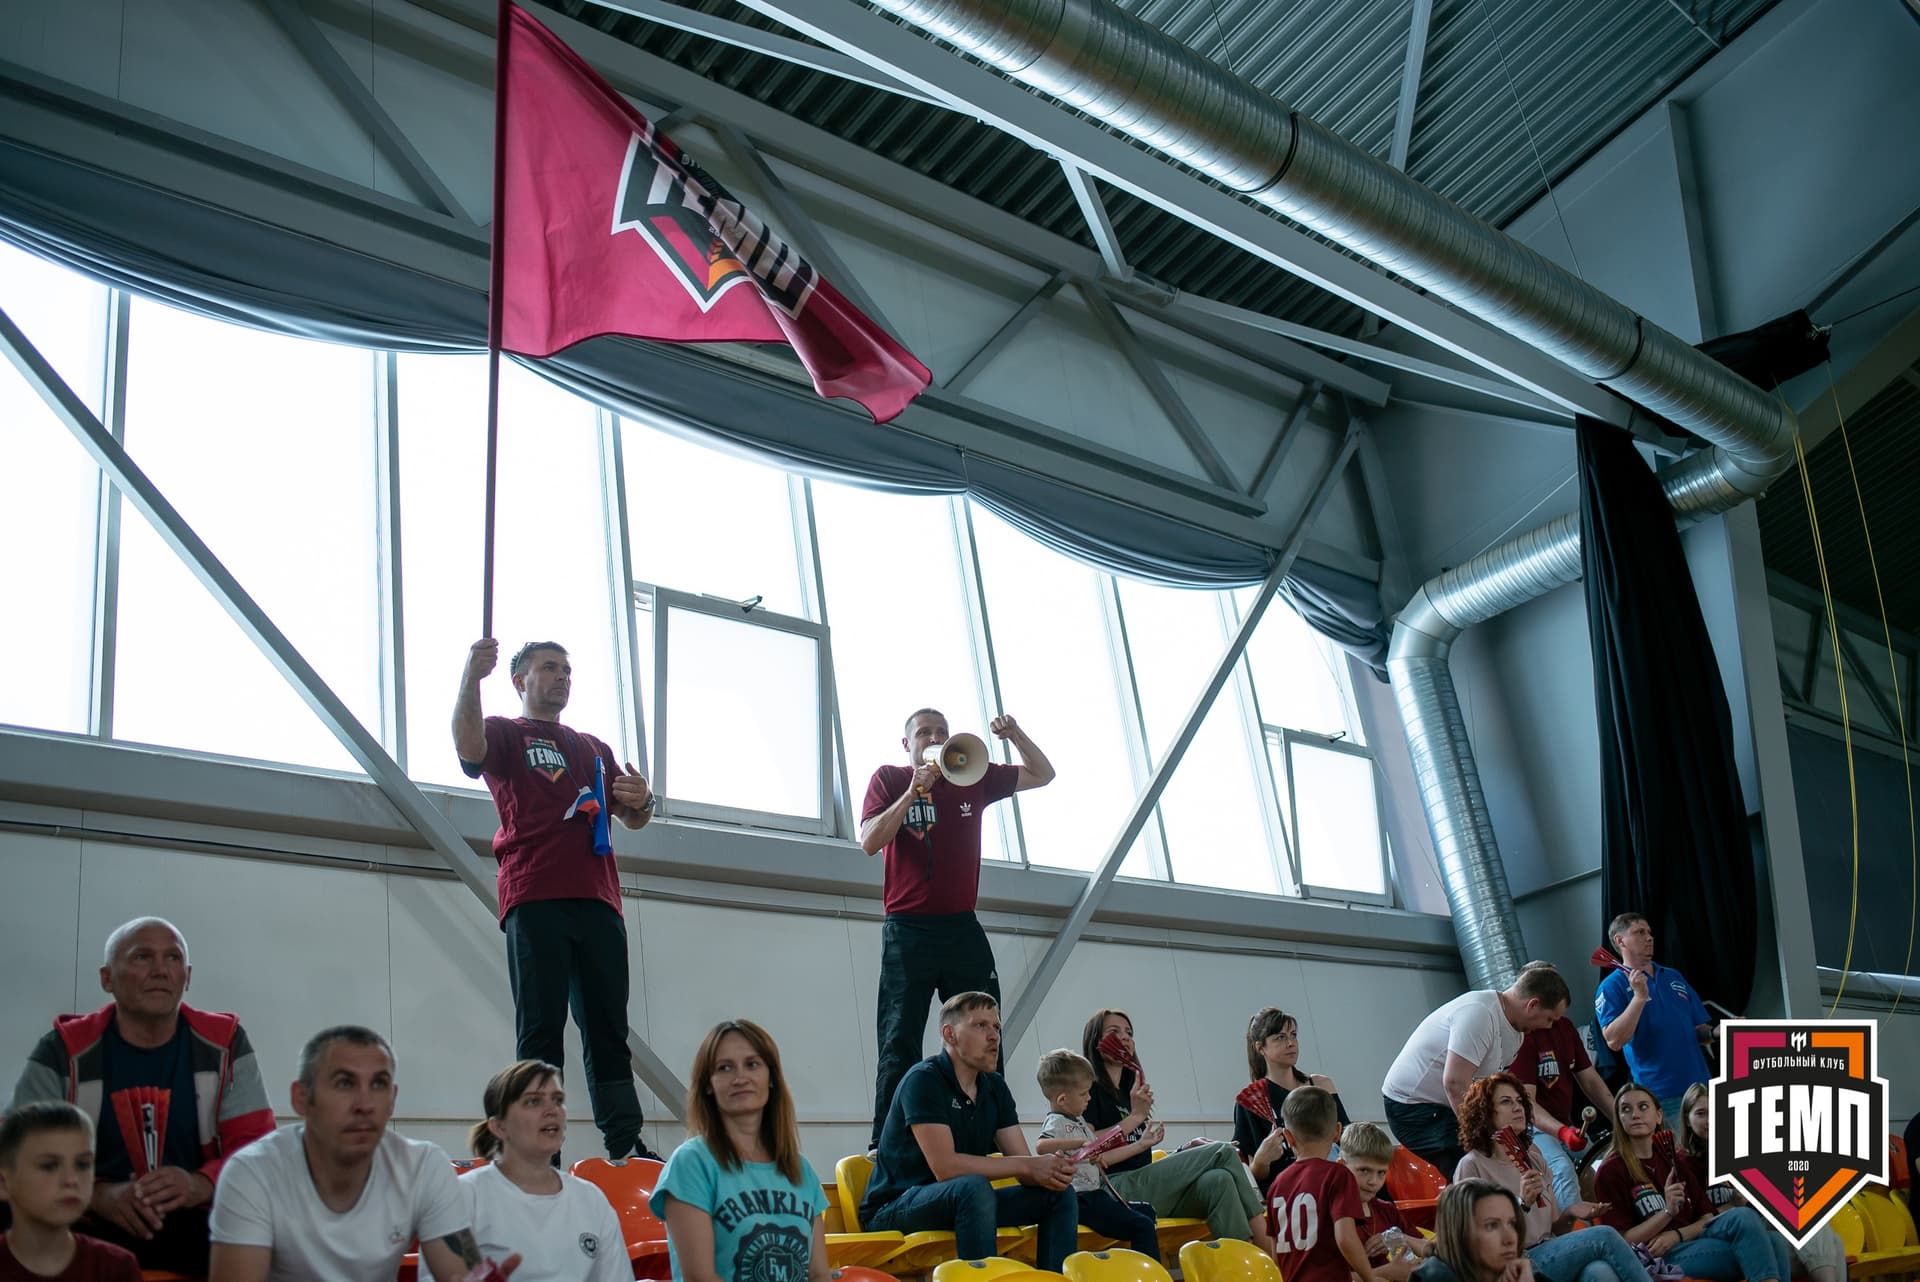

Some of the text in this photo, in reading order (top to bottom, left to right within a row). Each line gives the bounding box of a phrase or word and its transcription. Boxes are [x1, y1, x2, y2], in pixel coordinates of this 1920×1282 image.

[526, 748, 567, 767] ТЕМП
[903, 805, 936, 824] ЕМП
[1272, 1192, 1318, 1254] 10
